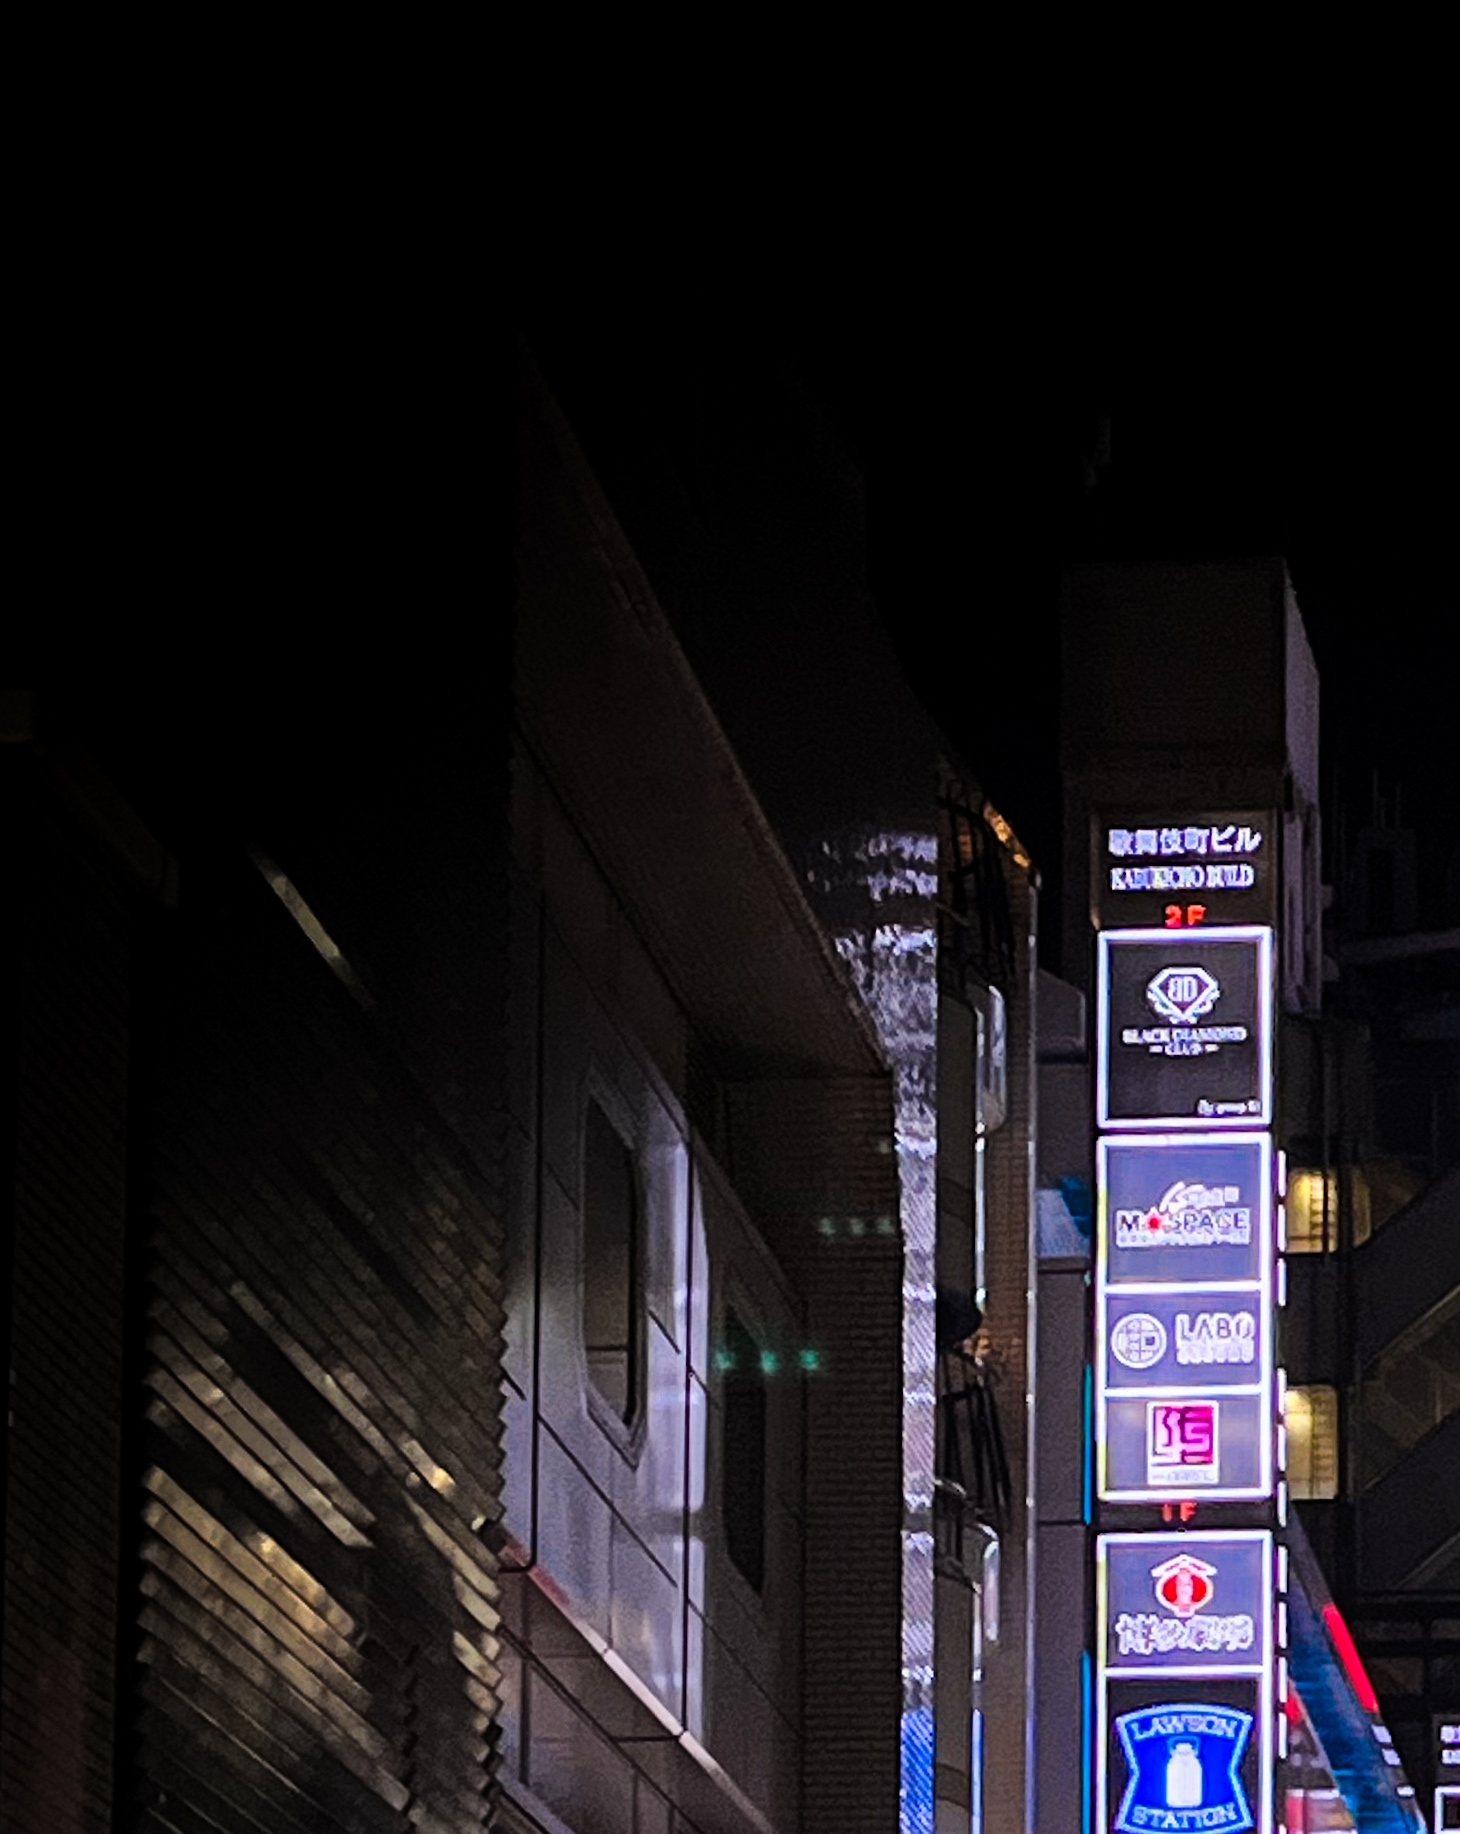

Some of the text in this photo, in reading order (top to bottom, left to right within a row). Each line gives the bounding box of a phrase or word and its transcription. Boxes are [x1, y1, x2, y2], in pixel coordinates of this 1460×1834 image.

[1108, 827, 1261, 857] 歌舞伎町ビル
[1131, 1715, 1238, 1741] LAWSON
[1131, 1803, 1238, 1831] STATION
